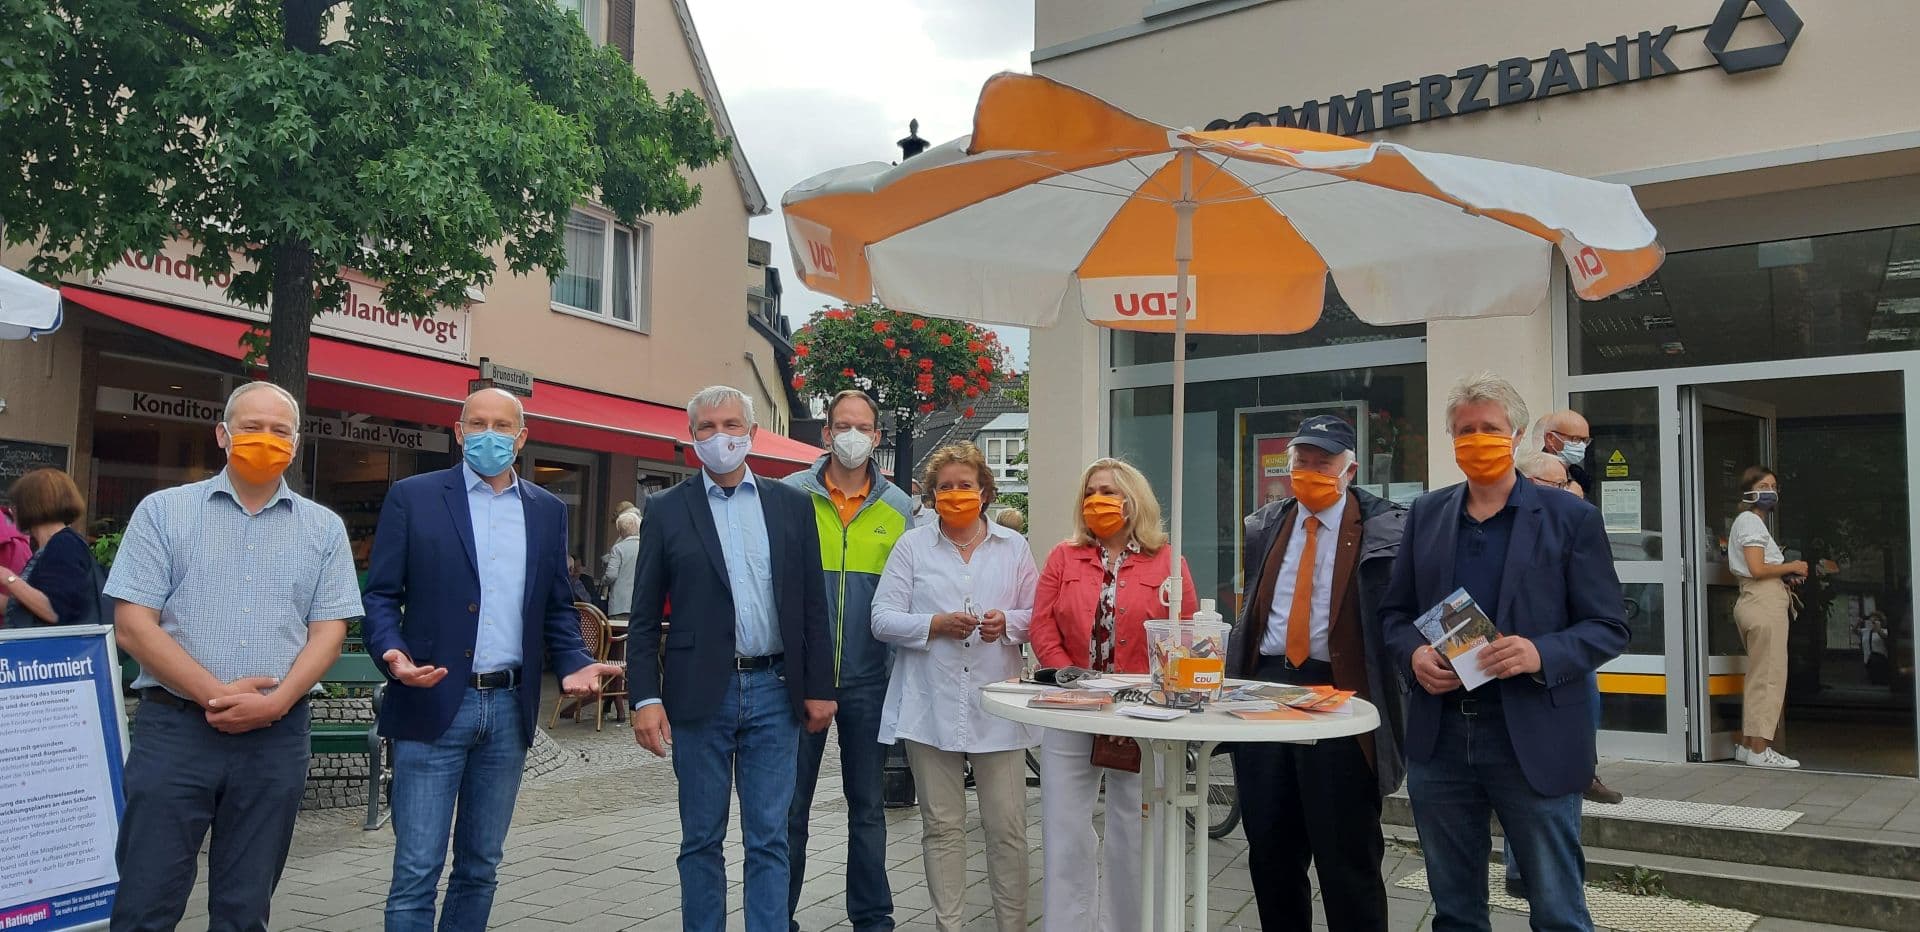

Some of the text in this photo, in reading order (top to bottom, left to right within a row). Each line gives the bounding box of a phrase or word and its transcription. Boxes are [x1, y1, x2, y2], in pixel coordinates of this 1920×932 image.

[1203, 25, 1680, 137] MMERZBANK
[492, 366, 529, 386] Brunostraße
[132, 392, 225, 421] Konditor
[340, 420, 423, 448] Jland-Vogt
[18, 656, 94, 682] informiert
[5, 908, 47, 929] Ratingen!
